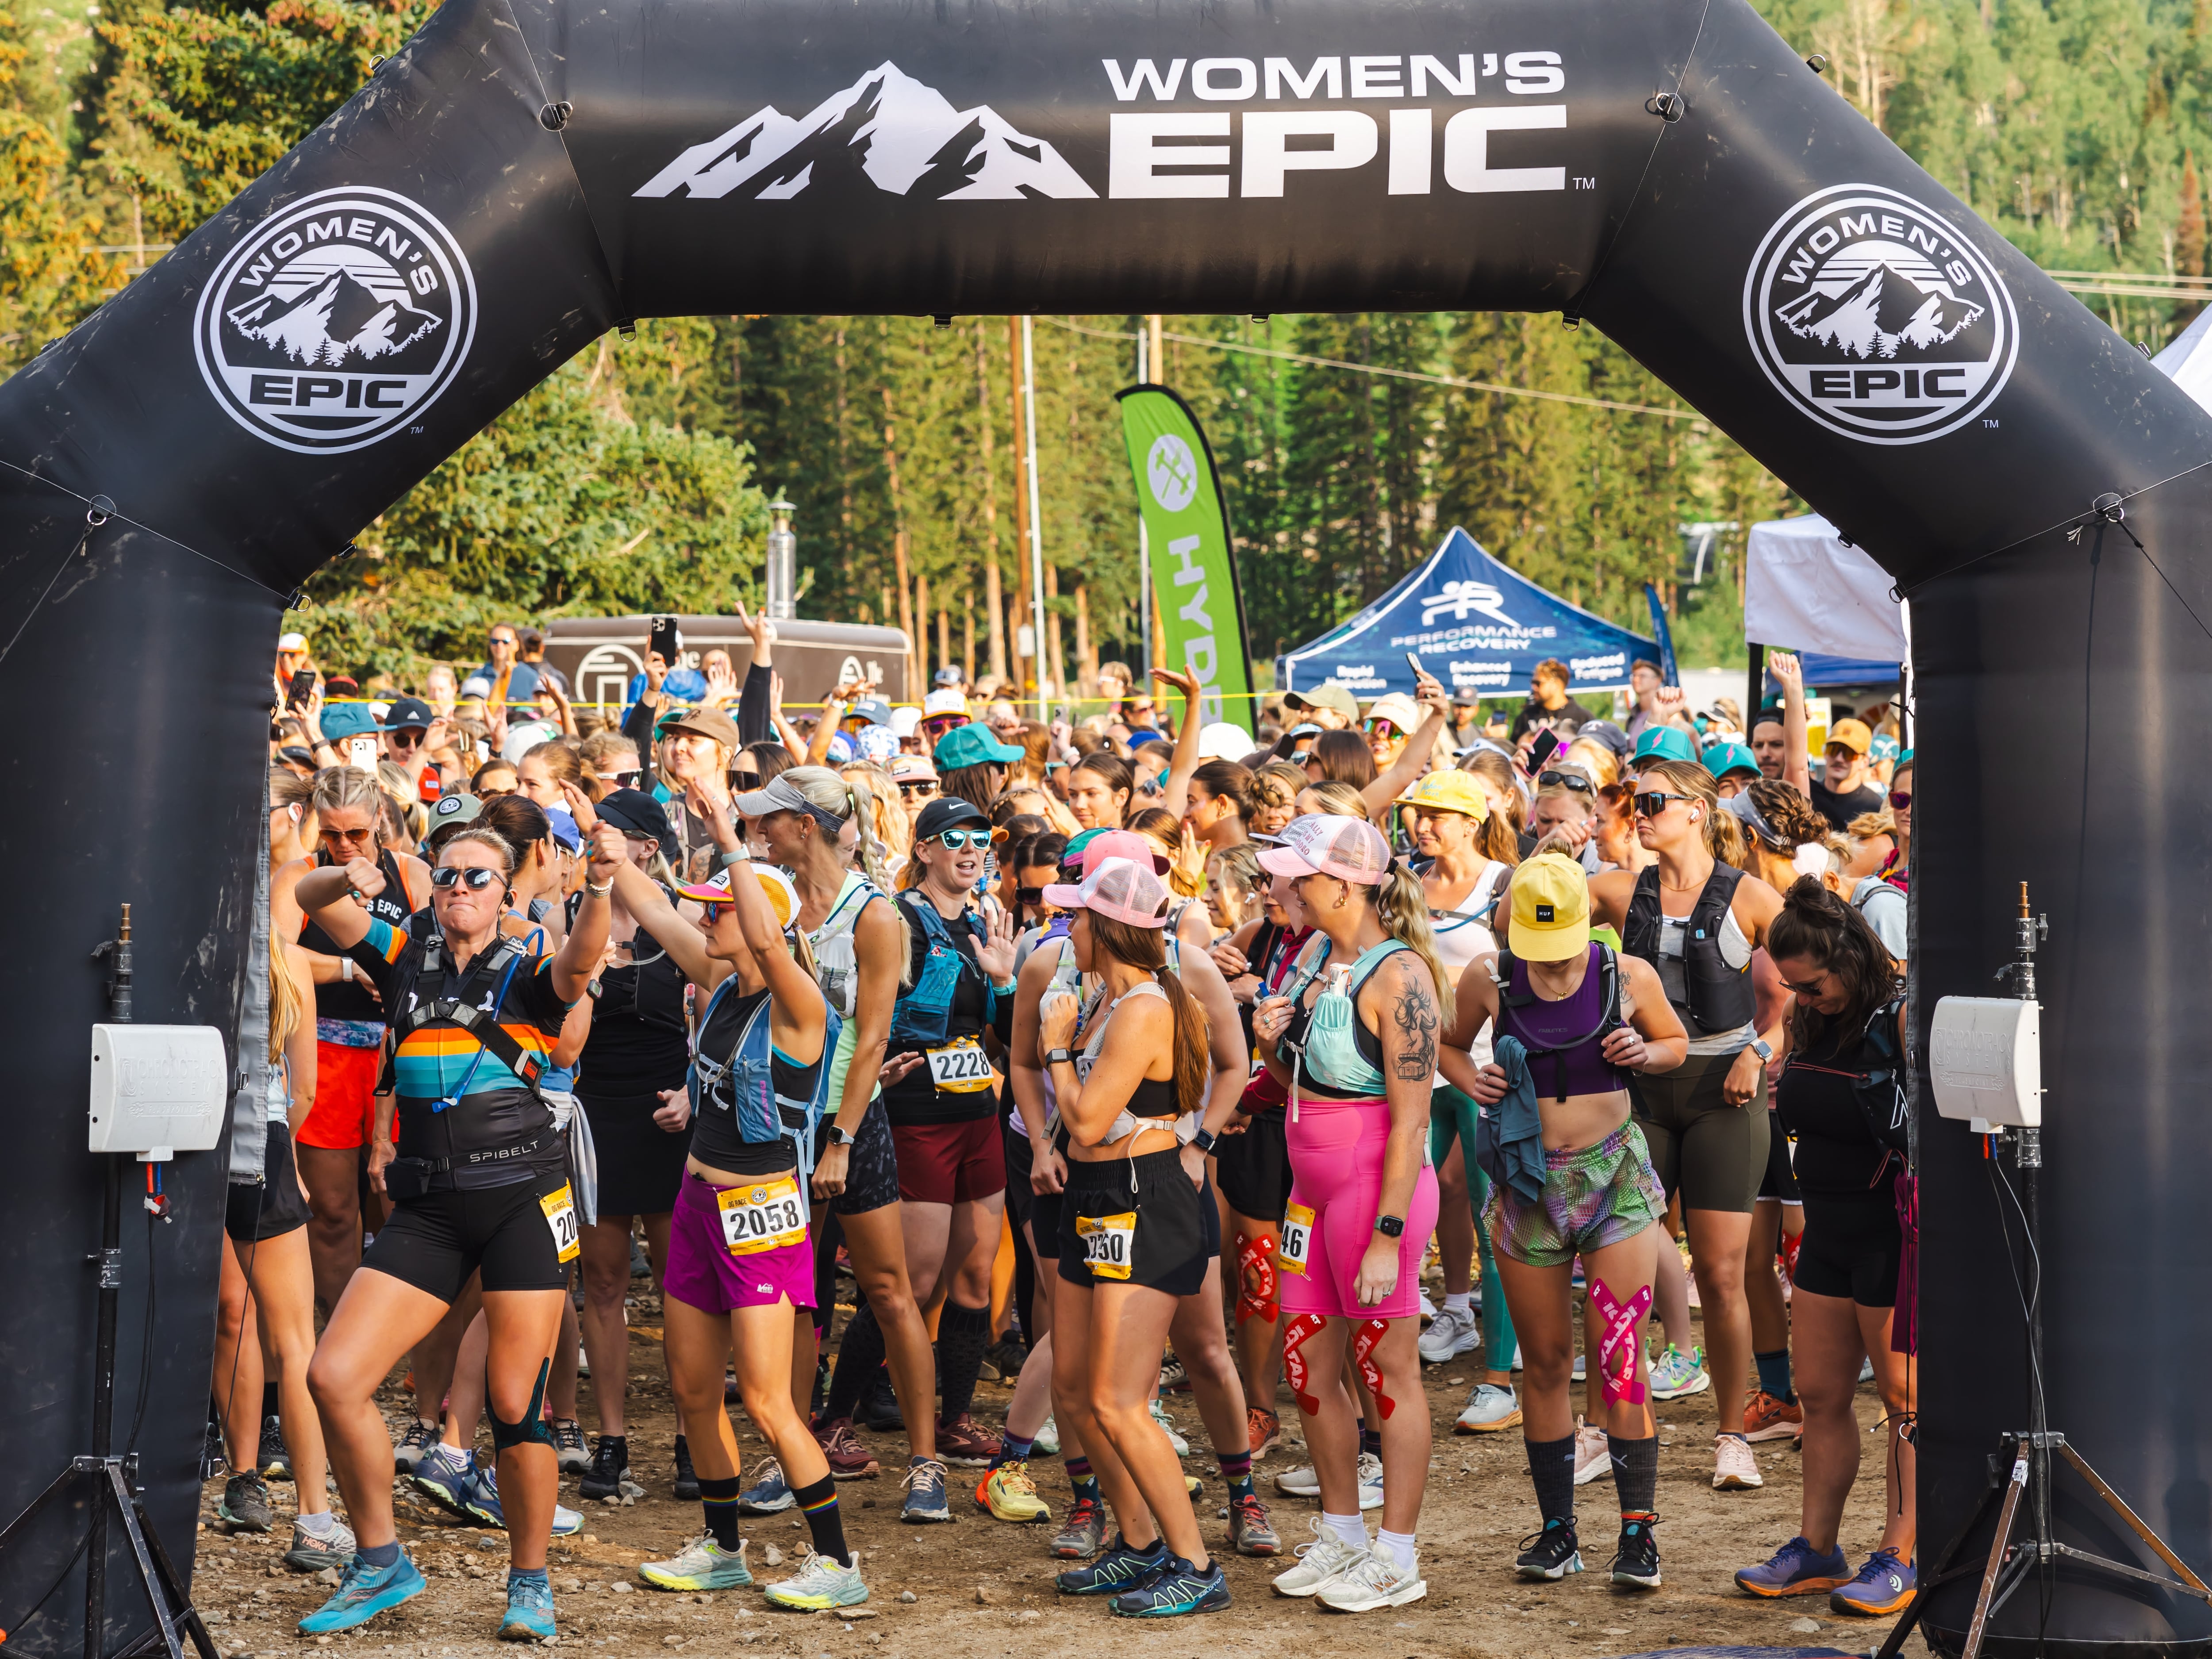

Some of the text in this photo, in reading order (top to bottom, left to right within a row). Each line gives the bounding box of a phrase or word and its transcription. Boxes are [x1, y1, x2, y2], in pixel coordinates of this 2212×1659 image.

[1102, 51, 1566, 101] WOMEN'S
[1109, 104, 1595, 199] EPIC TM
[239, 216, 438, 296] WOMEN'S
[1781, 212, 1972, 286] WOMEN'S
[249, 373, 407, 409] EPIC
[1809, 368, 1967, 399] EPIC
[410, 426, 424, 434] TM
[1982, 419, 1999, 428] TM
[1390, 625, 1558, 648] PERFORMANCE
[1418, 637, 1532, 655] RECOVERY
[376, 898, 403, 920] EPIC
[936, 1051, 990, 1080] 2228
[470, 1140, 538, 1163] SPIBELT
[735, 1198, 747, 1206] RACE
[557, 1210, 576, 1247] 20
[730, 1200, 799, 1240] 2058
[1372, 1319, 1384, 1329] KT
[1287, 1350, 1303, 1390] TAP
[301, 1536, 327, 1553] HOKA
[1198, 1575, 1223, 1599] salomon
